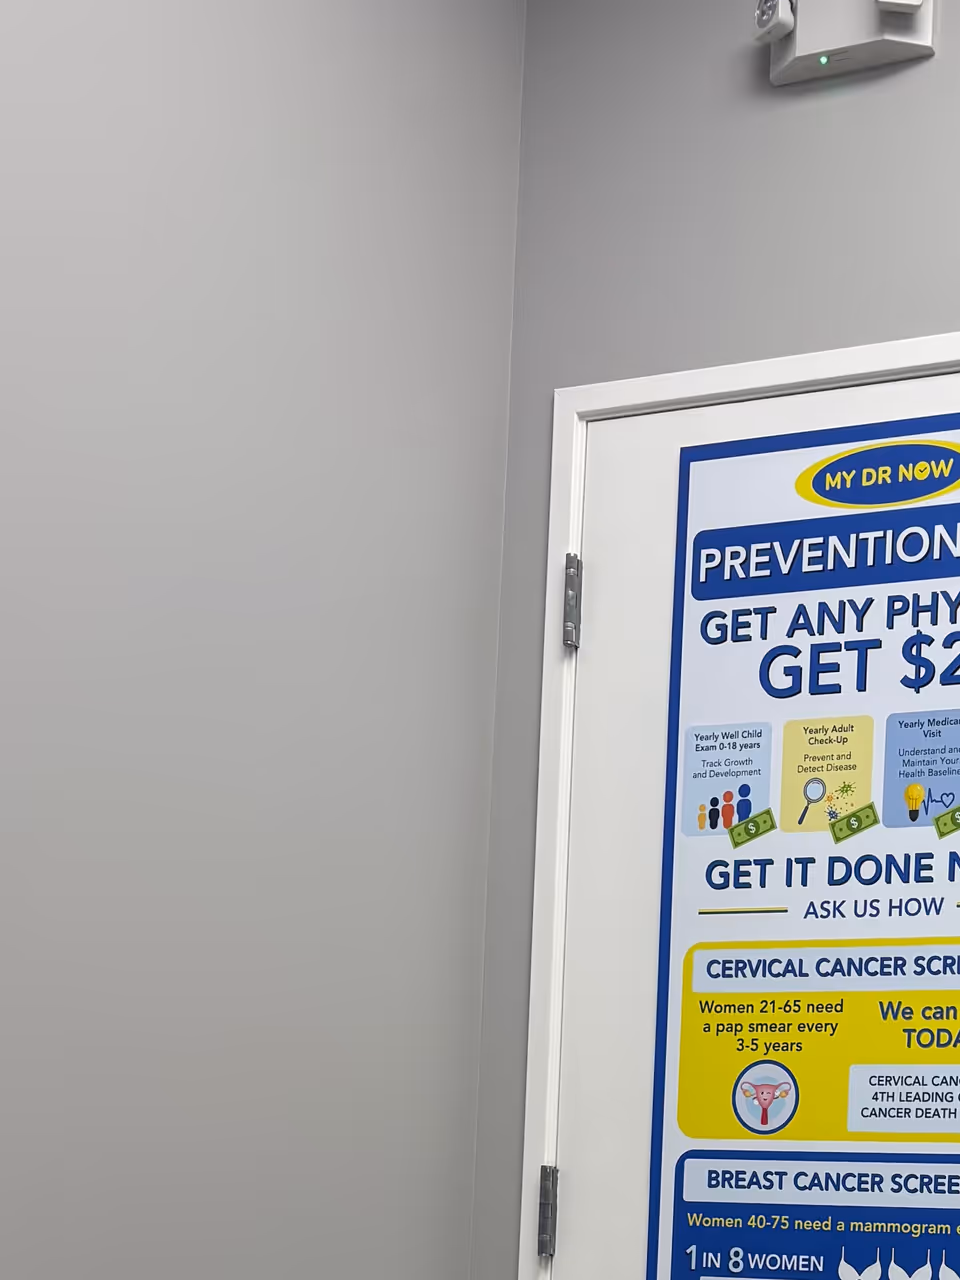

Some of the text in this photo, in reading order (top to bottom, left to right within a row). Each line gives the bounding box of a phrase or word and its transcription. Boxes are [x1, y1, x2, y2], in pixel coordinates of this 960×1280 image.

[826, 459, 954, 491] MY DR NOW
[701, 607, 776, 644] GET
[786, 597, 874, 637] ANY
[759, 639, 881, 698] GET
[803, 724, 854, 735] Yearly Adult
[899, 720, 925, 729] Yearly
[694, 730, 762, 742] Yearly Well Child
[923, 730, 941, 738] Visit
[695, 742, 760, 751] Exam 0-18 years
[808, 735, 848, 746] Check-Up
[804, 752, 851, 762] Prevent and
[899, 747, 946, 756] Understand
[702, 758, 753, 767] Track Growth
[902, 757, 959, 767] Maintain Your
[693, 769, 761, 779] and Development
[798, 765, 824, 774] Detect
[899, 769, 925, 778] Health
[705, 858, 774, 890] GET
[785, 857, 815, 888] IT
[827, 852, 934, 886] DONE
[804, 897, 944, 919] ASK US HOW
[706, 958, 808, 979] CERVICAL
[815, 955, 906, 977] CANCER
[700, 999, 844, 1014] Women 21-65 need
[879, 1001, 913, 1021] We
[921, 1004, 955, 1021] can
[703, 1020, 839, 1036] a pap smear every
[736, 1039, 803, 1054] 3-5 years
[869, 1075, 928, 1088] CERVICAL
[871, 1091, 896, 1103] 4TH
[899, 1091, 954, 1103] LEADING
[861, 1107, 911, 1119] CANCER
[915, 1107, 957, 1119] DEATH
[707, 1170, 787, 1191] BREAST
[793, 1172, 884, 1193] CANCER
[687, 1213, 742, 1228] Women
[747, 1215, 789, 1229] 40-75
[795, 1216, 831, 1231] need
[837, 1221, 845, 1232] a
[850, 1220, 951, 1237] mammogram
[686, 1244, 823, 1273] 1 IN 8 WOMEN
